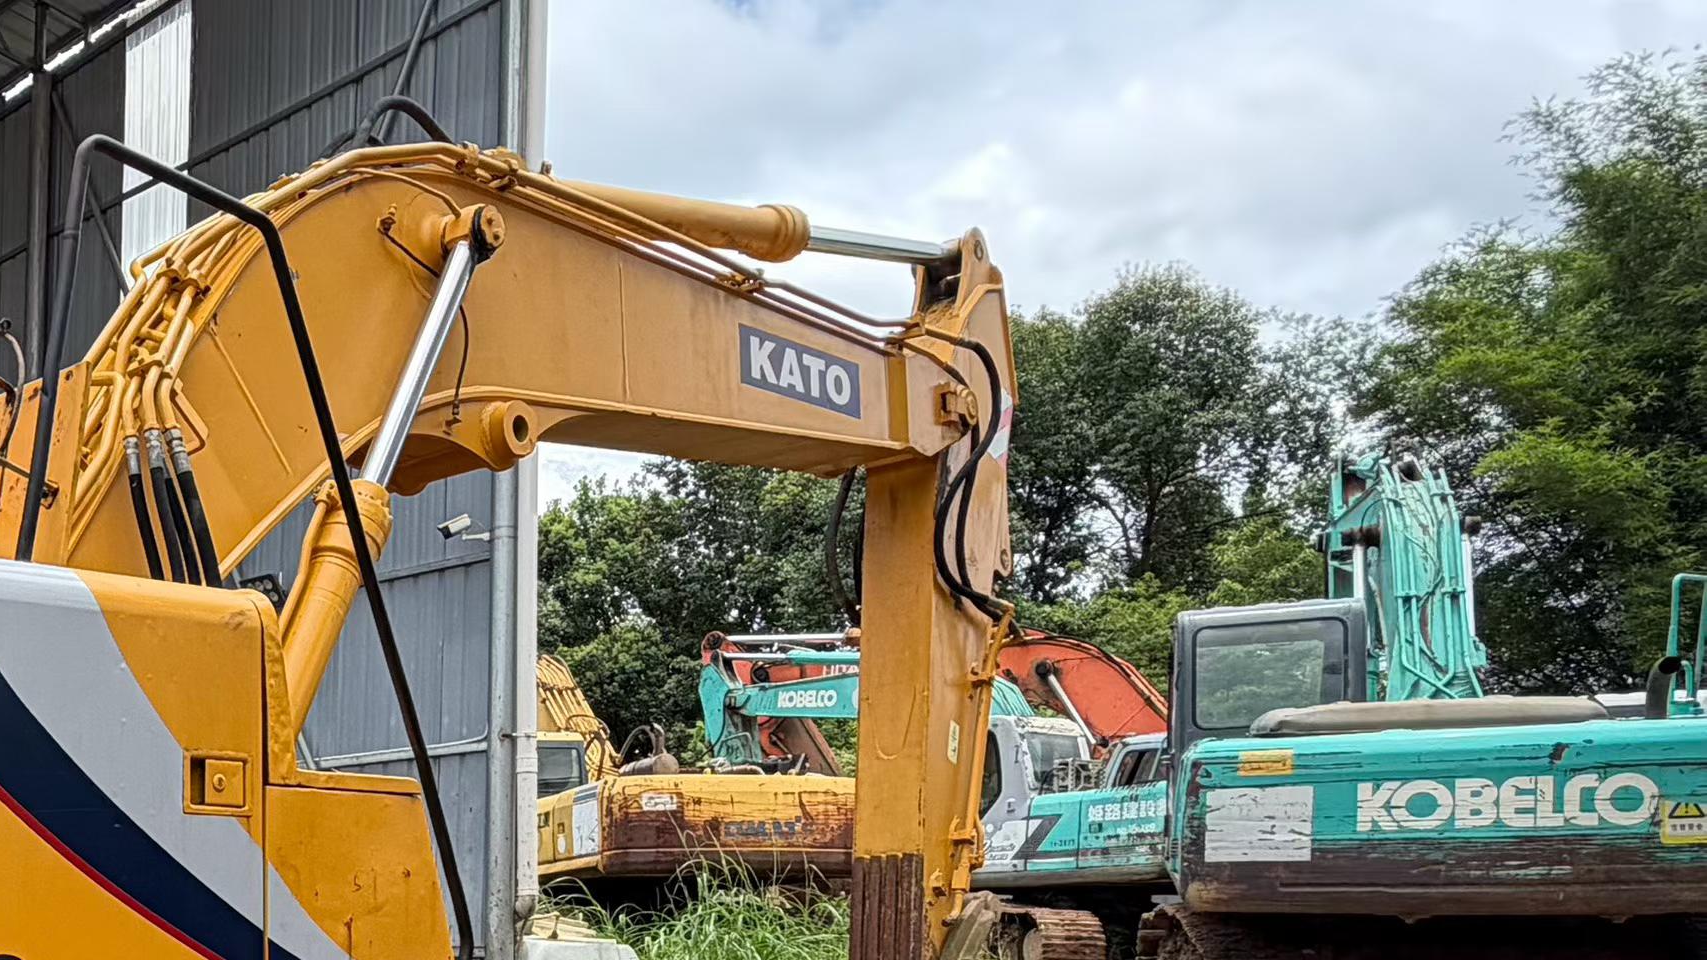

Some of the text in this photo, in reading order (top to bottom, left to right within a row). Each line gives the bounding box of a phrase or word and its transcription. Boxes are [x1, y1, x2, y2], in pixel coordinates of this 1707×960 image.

[750, 336, 851, 406] KATO
[777, 690, 838, 708] KOBELCO
[1356, 773, 1660, 832] KOBELCO
